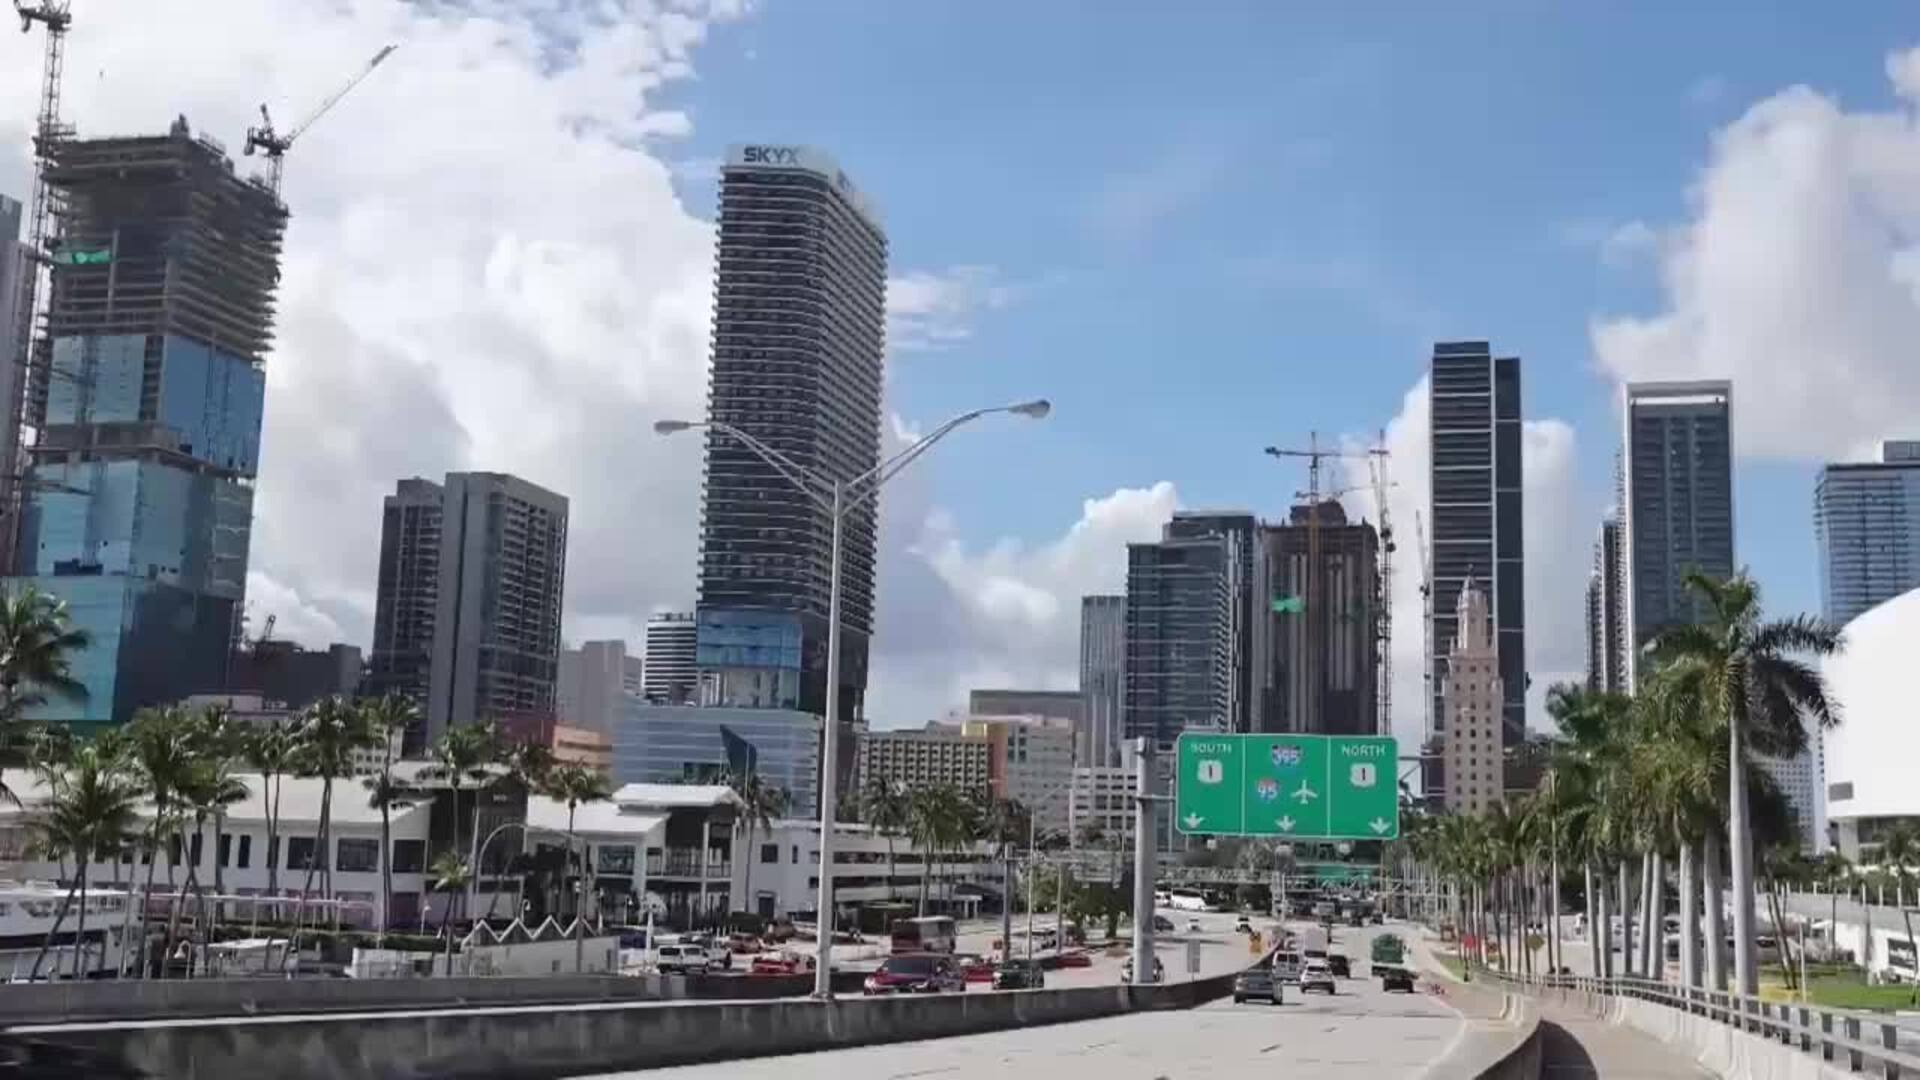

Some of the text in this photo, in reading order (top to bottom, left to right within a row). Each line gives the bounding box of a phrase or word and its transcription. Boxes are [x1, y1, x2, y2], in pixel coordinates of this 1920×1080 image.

[1190, 743, 1232, 754] SOUTH
[1342, 744, 1386, 757] NORTH
[1257, 784, 1278, 799] 95
